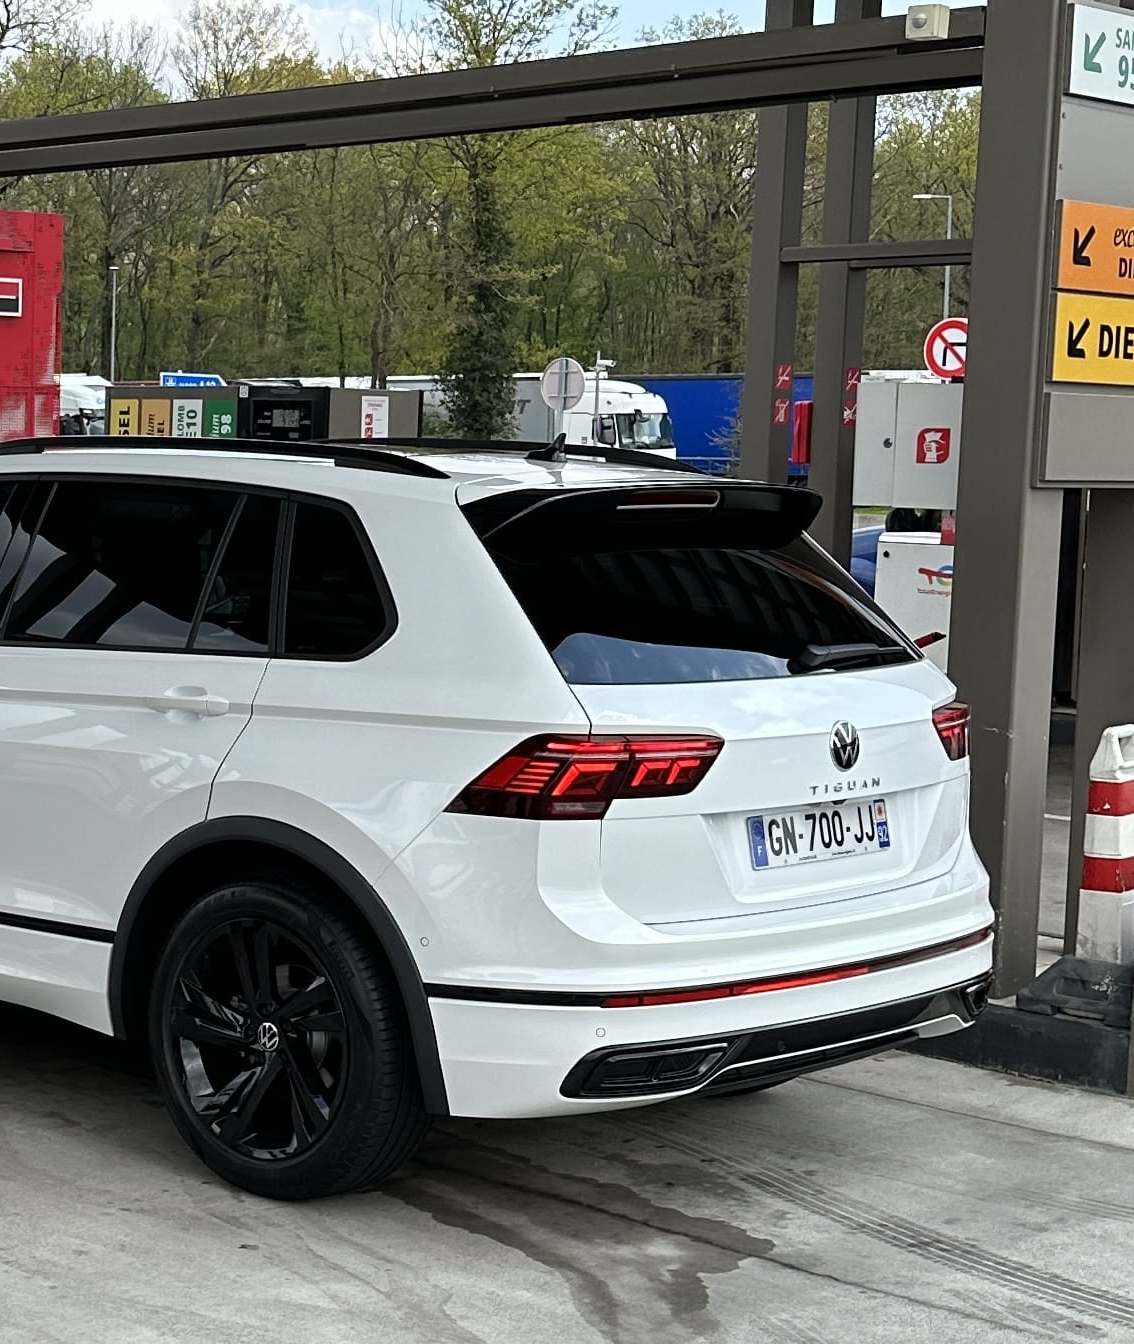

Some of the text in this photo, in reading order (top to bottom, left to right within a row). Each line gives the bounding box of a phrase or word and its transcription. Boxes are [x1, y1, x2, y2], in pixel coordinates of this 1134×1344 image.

[1118, 257, 1134, 279] DI
[221, 414, 232, 435] 98
[809, 777, 881, 796] TIGUAN
[767, 804, 876, 857] GN-700-JJ
[756, 845, 763, 857] F
